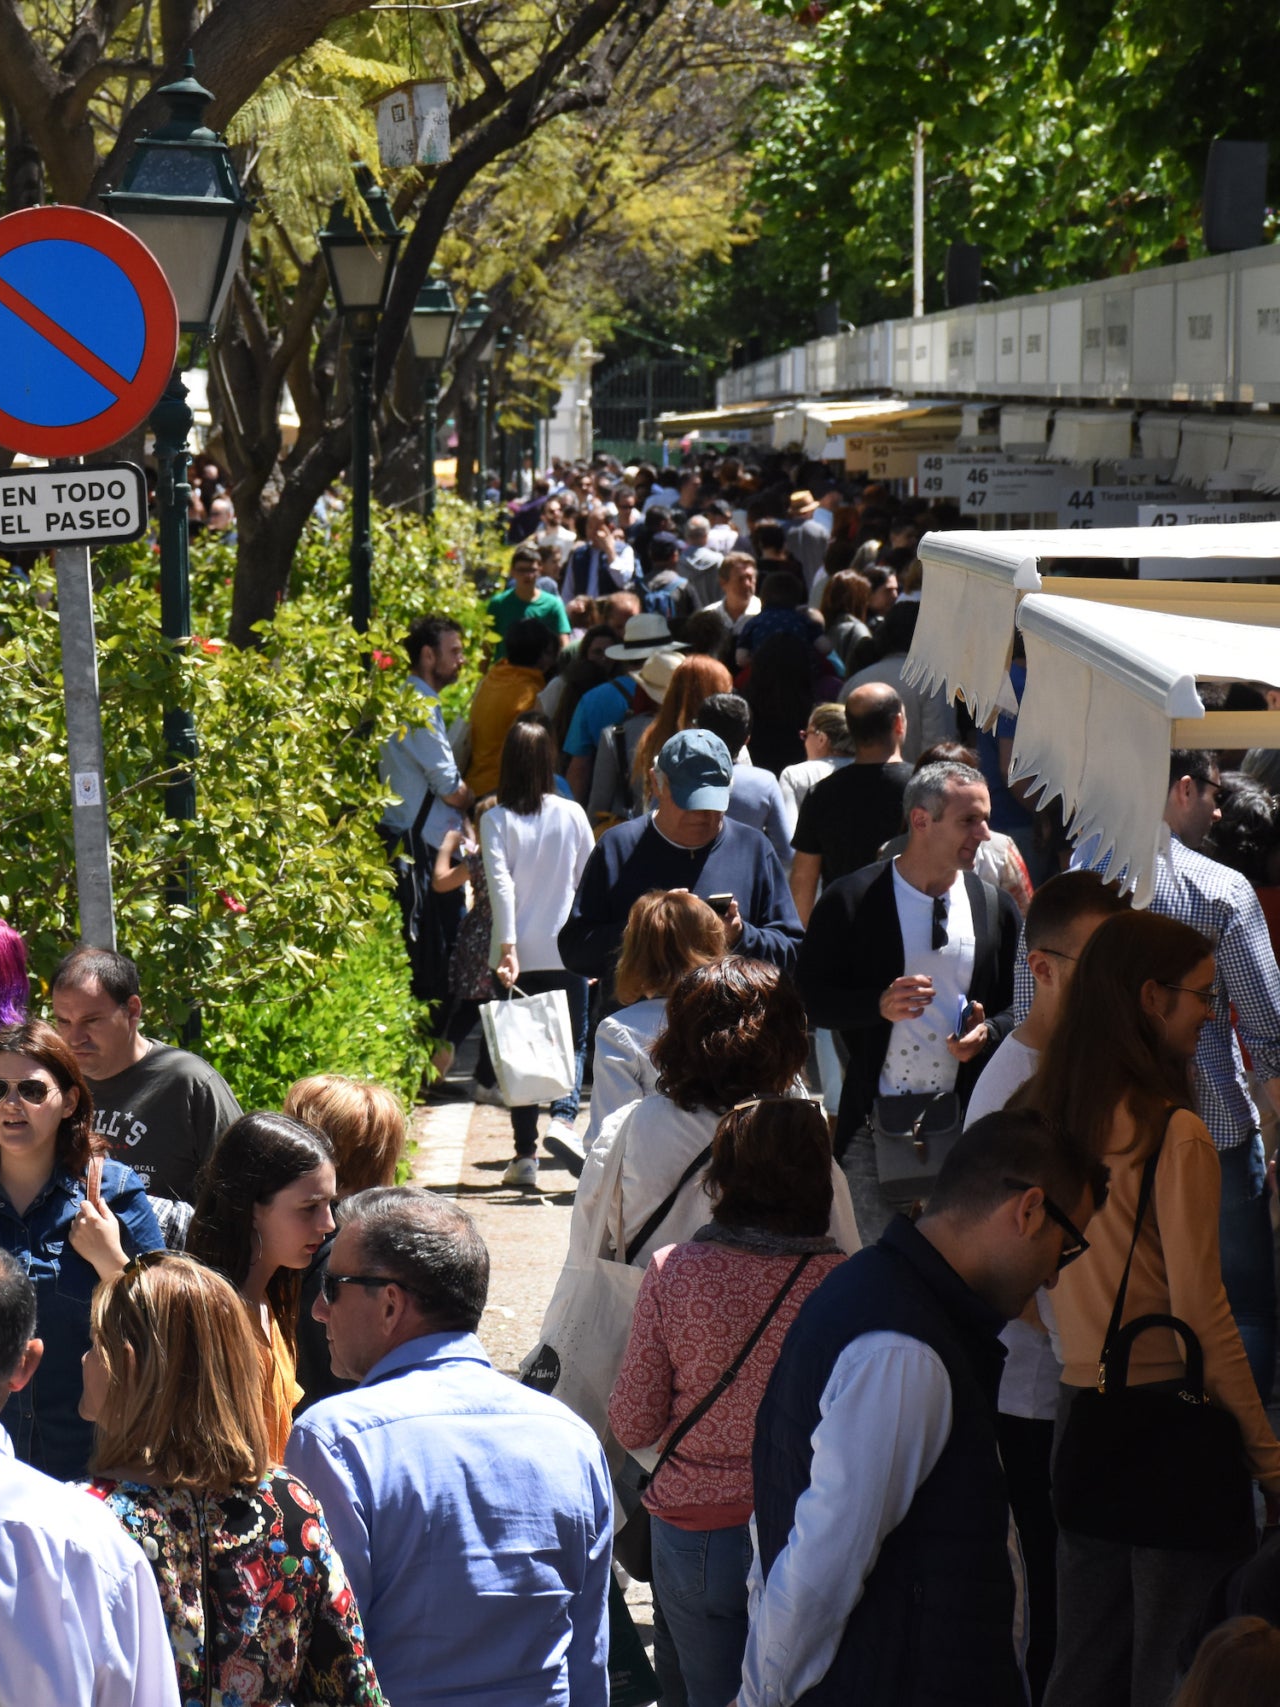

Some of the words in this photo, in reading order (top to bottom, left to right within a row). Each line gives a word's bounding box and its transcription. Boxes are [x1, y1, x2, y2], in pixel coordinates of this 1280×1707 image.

[872, 446, 889, 458] 50
[872, 462, 887, 474] 51
[924, 457, 943, 471] 48
[967, 468, 989, 484] 46
[924, 477, 943, 491] 49
[2, 486, 36, 507] EN
[52, 480, 126, 503] TODO
[967, 491, 987, 506] 47
[1067, 490, 1095, 509] 44
[1, 515, 31, 535] EL
[46, 508, 131, 532] PASEO
[1186, 514, 1221, 525] Tirant
[1223, 513, 1237, 523] Lo
[1239, 512, 1277, 523] Blanch
